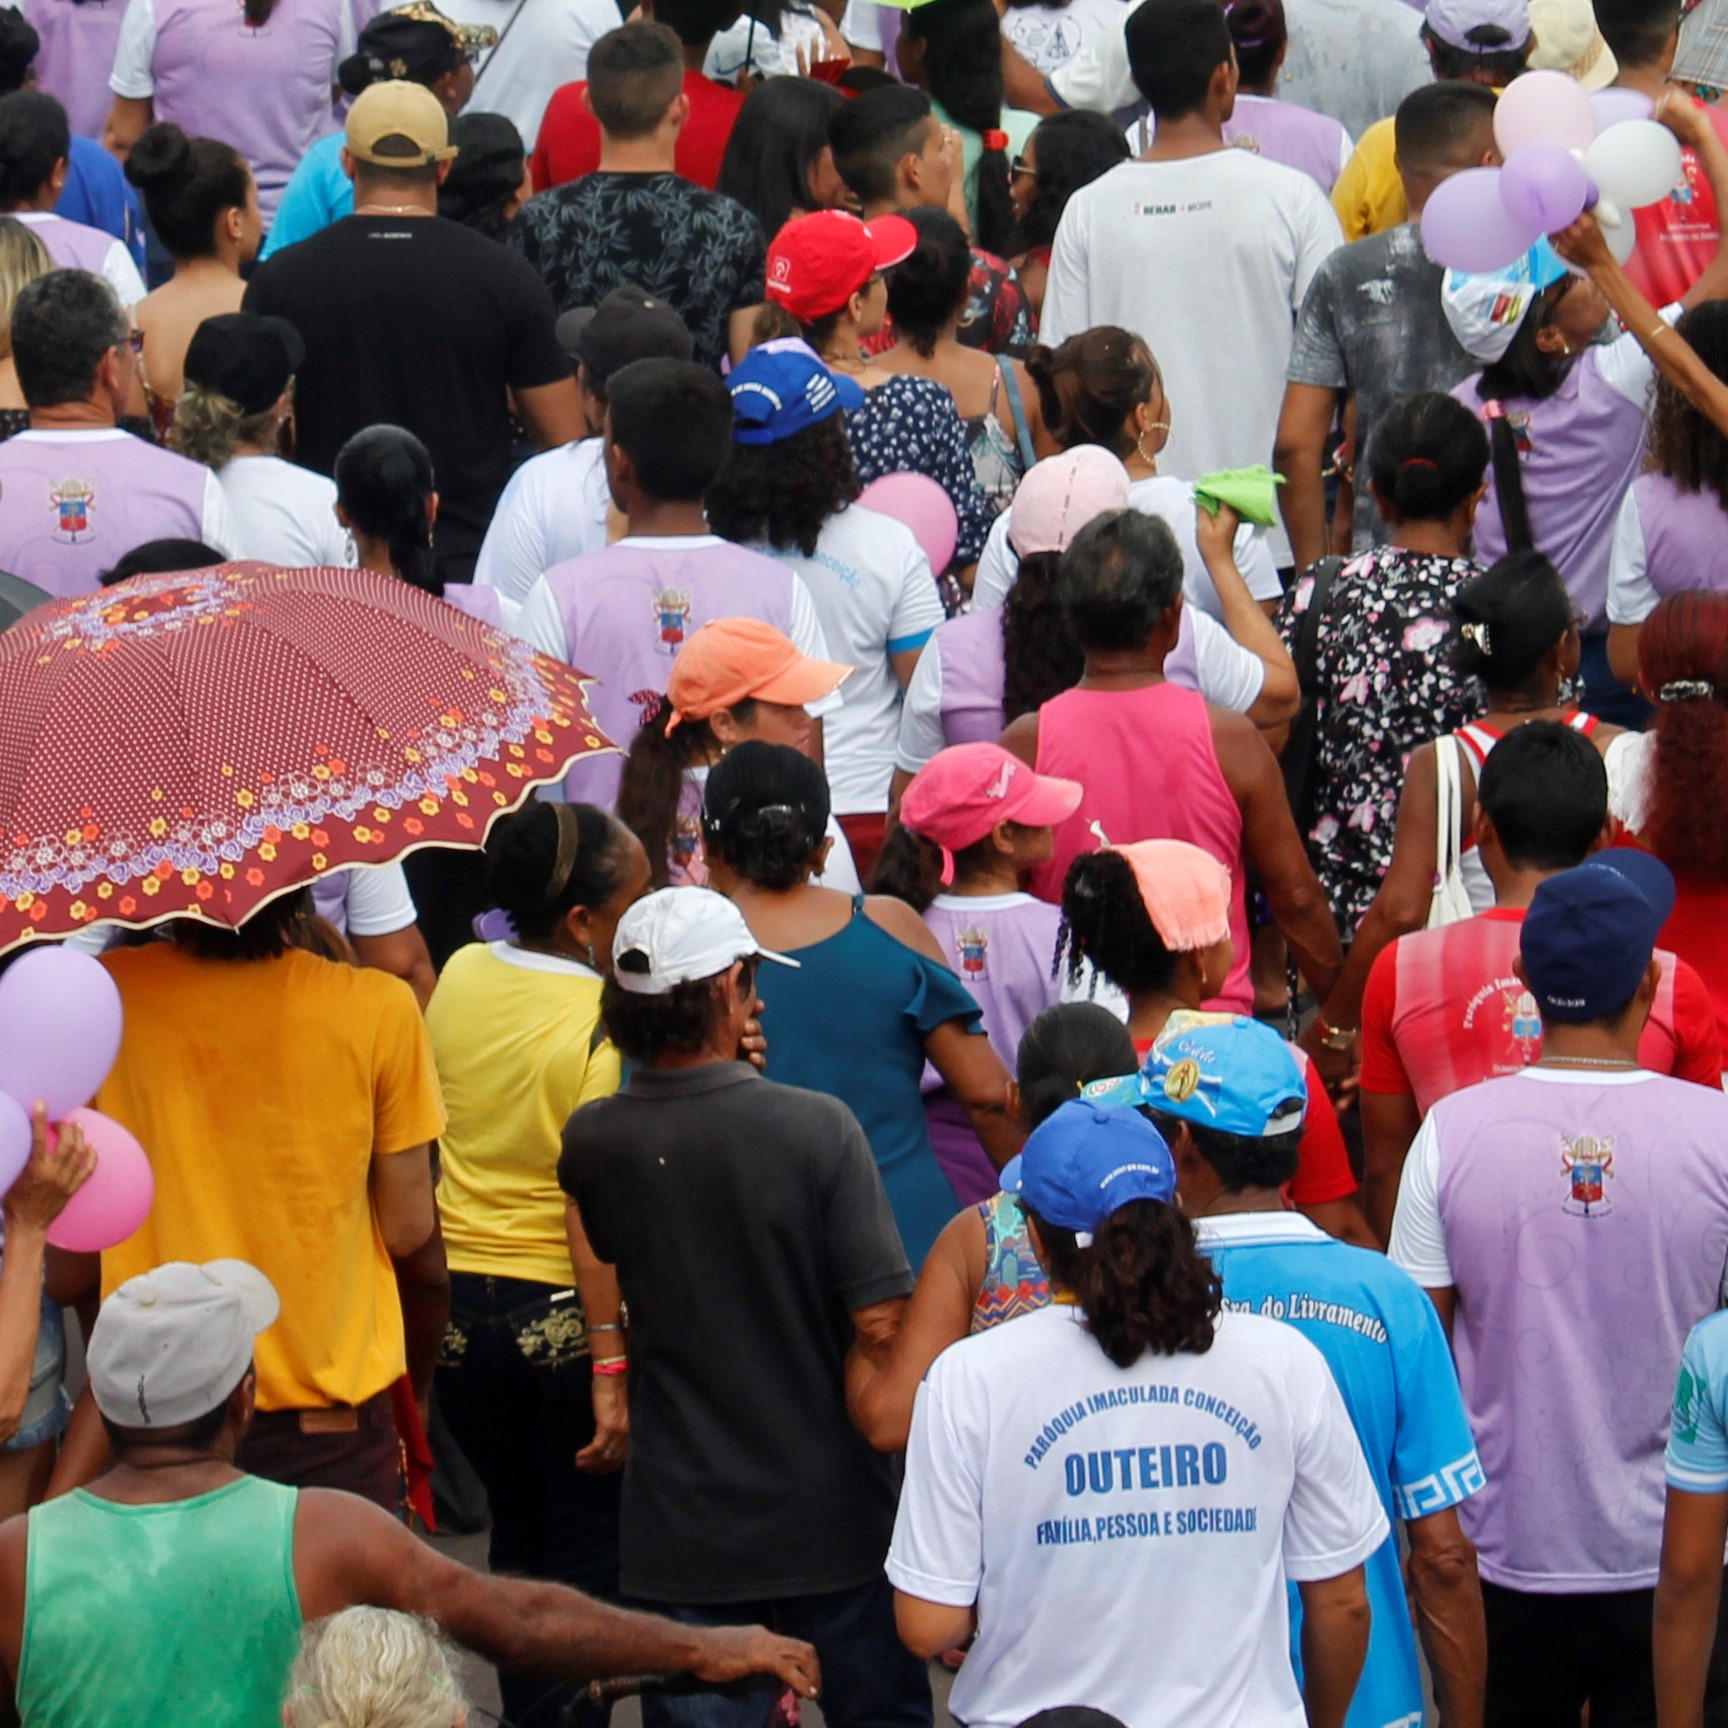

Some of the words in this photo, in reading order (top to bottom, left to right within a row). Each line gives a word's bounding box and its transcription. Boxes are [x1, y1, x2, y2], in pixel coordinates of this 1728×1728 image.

[1261, 1295, 1284, 1319] do
[1288, 1293, 1388, 1345] Livramento
[1023, 1399, 1088, 1471] PARÓQUIA
[1087, 1384, 1180, 1415] IMACULADA
[1183, 1387, 1262, 1452] CONCEIÇÃO
[1063, 1441, 1228, 1498] OUTEIRO
[1163, 1511, 1173, 1535] E
